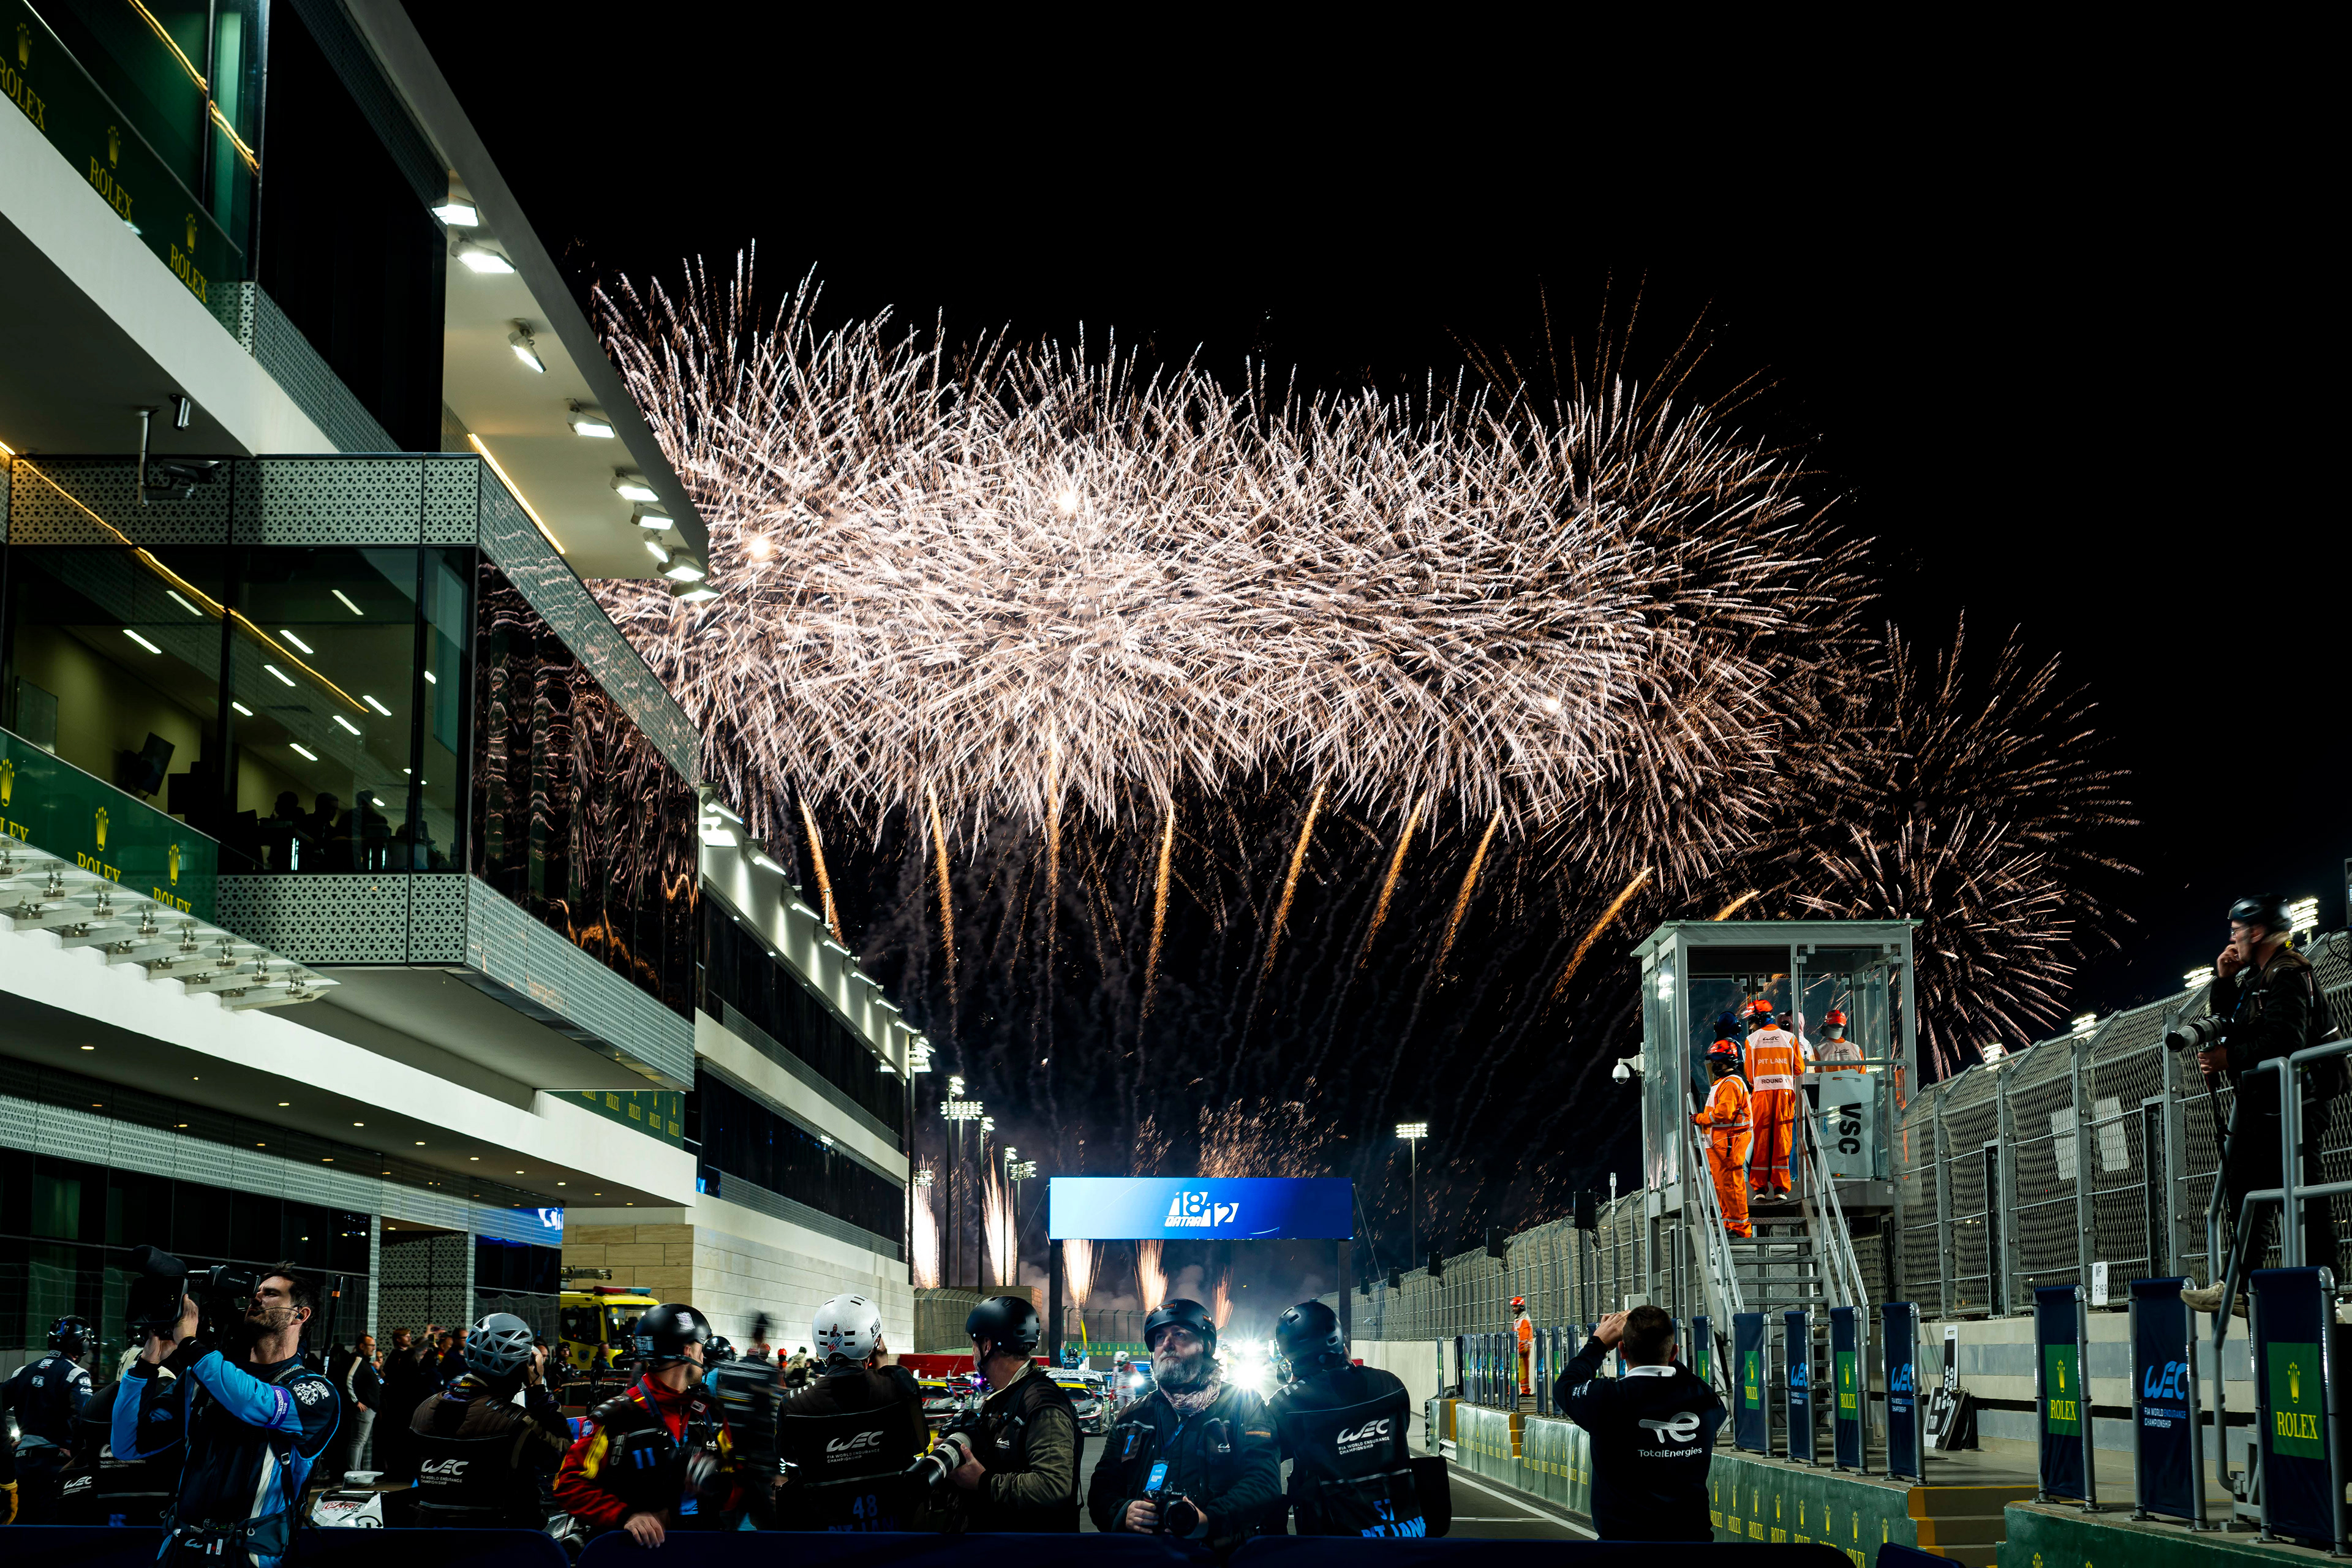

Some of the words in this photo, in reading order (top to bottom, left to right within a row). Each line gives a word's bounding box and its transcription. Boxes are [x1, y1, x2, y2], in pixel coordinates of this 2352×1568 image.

[0, 56, 46, 131] ROLEX
[89, 156, 133, 224] ROLEX
[170, 243, 207, 304] ROLEX
[1838, 1102, 1862, 1155] VSC
[1164, 1216, 1202, 1227] QATAR
[2095, 1265, 2102, 1277] MP
[2095, 1284, 2098, 1295] F
[1891, 1363, 1913, 1392] WEC
[1941, 1365, 1950, 1409] STOP
[2144, 1360, 2187, 1400] WEC
[1745, 1386, 1758, 1400] ROLEX
[1841, 1393, 1856, 1408] ROLEX
[2050, 1400, 2076, 1420] ROLEX
[2151, 1408, 2163, 1417] WORLD
[1337, 1419, 1390, 1444] WEC
[2144, 1418, 2171, 1428] CHAMPIONSHIP
[2276, 1411, 2318, 1439] ROLEX
[826, 1431, 884, 1452] WEC
[1340, 1444, 1374, 1455] CHAMPIONSHIP
[1364, 1436, 1390, 1445] ENDURANCE
[1638, 1447, 1702, 1458] TotalEnergies
[421, 1459, 469, 1476] WEC
[63, 1476, 92, 1490] WEC
[853, 1494, 878, 1519] 48
[1728, 1515, 1741, 1534] ROLEX
[1749, 1521, 1763, 1540] ROLEX
